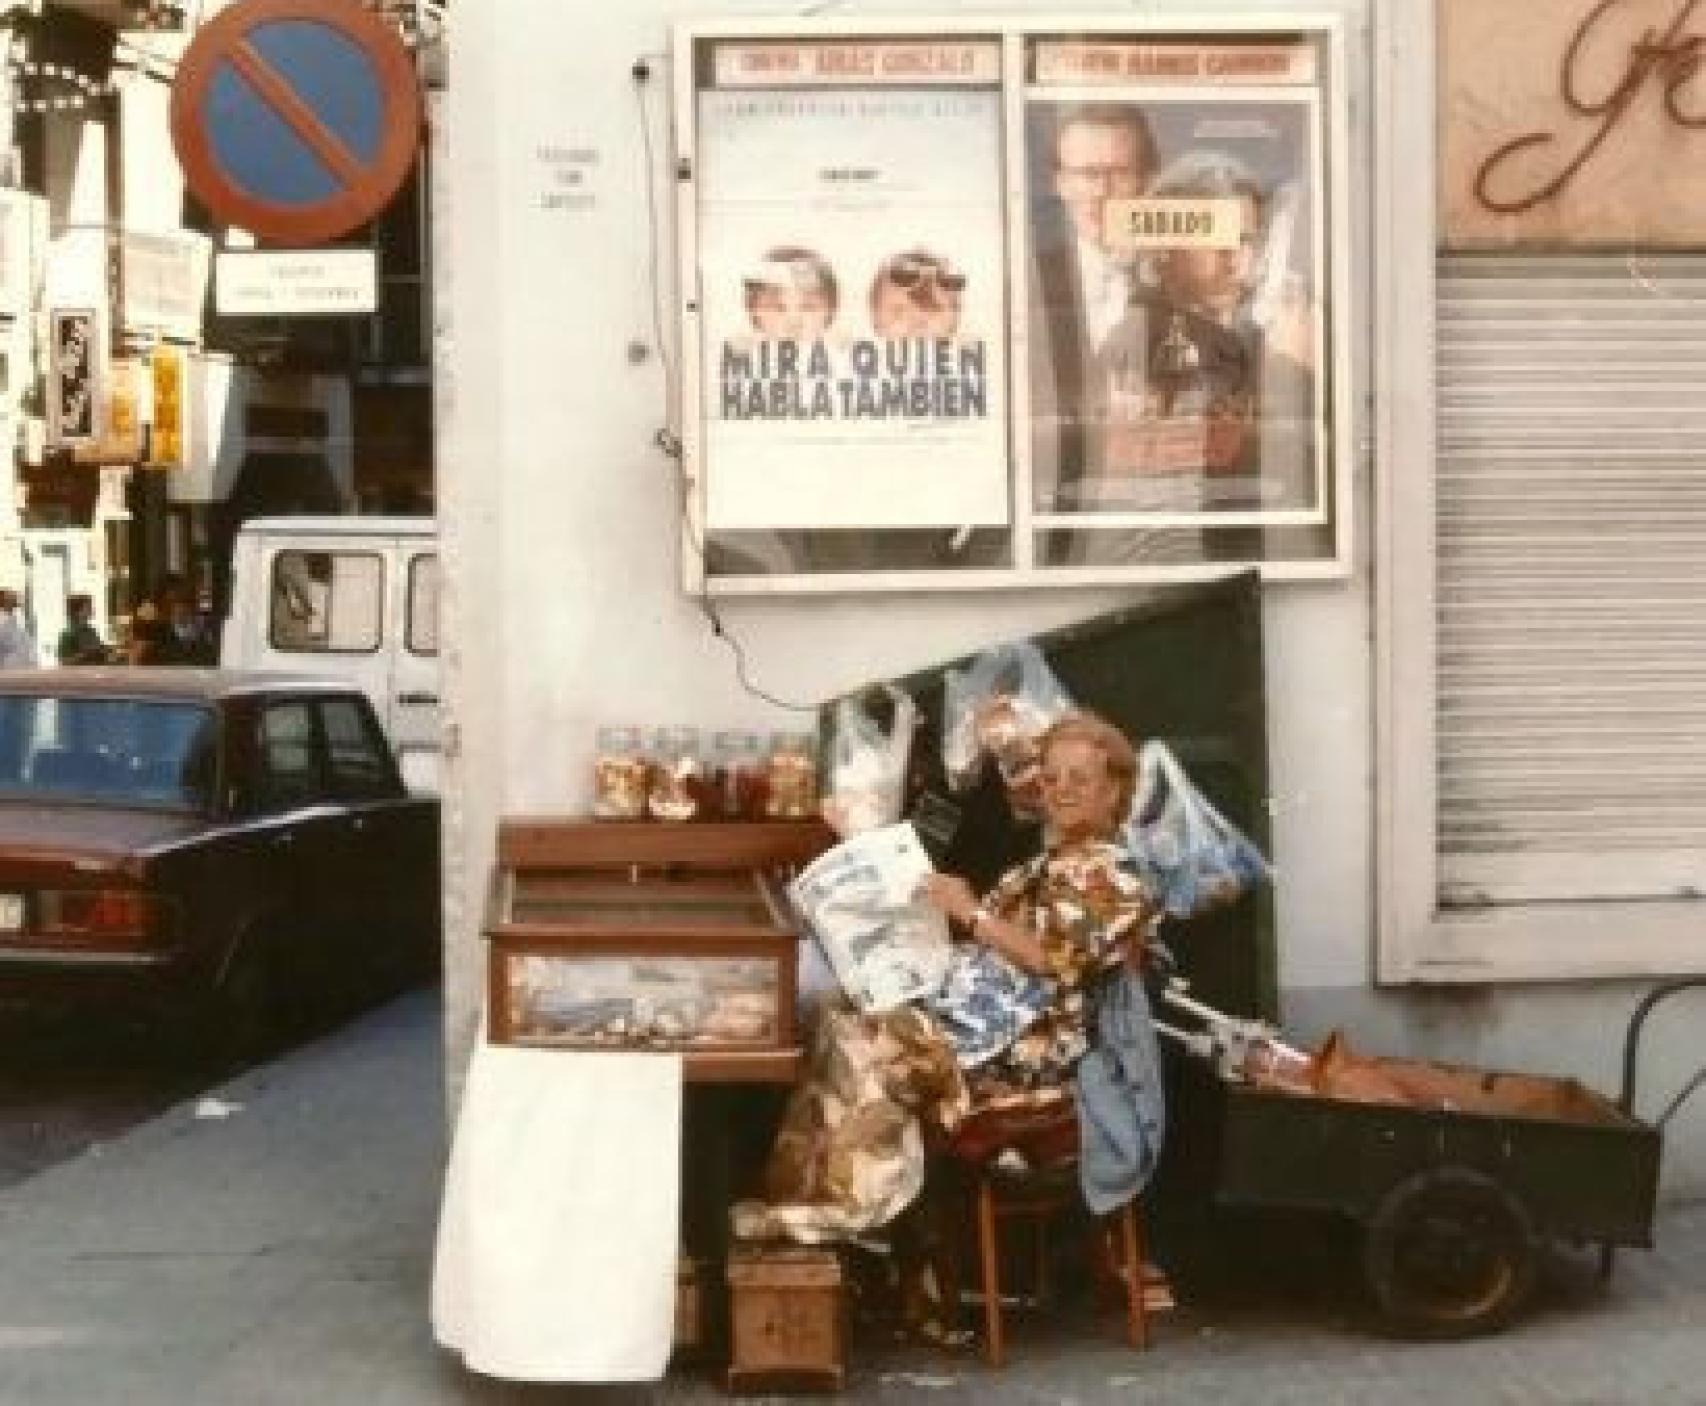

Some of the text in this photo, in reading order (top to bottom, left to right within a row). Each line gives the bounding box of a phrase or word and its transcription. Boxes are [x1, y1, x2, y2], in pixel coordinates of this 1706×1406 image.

[721, 339, 987, 379] MIRA QUIEN
[721, 379, 987, 419] HABLA TAMBIEN
